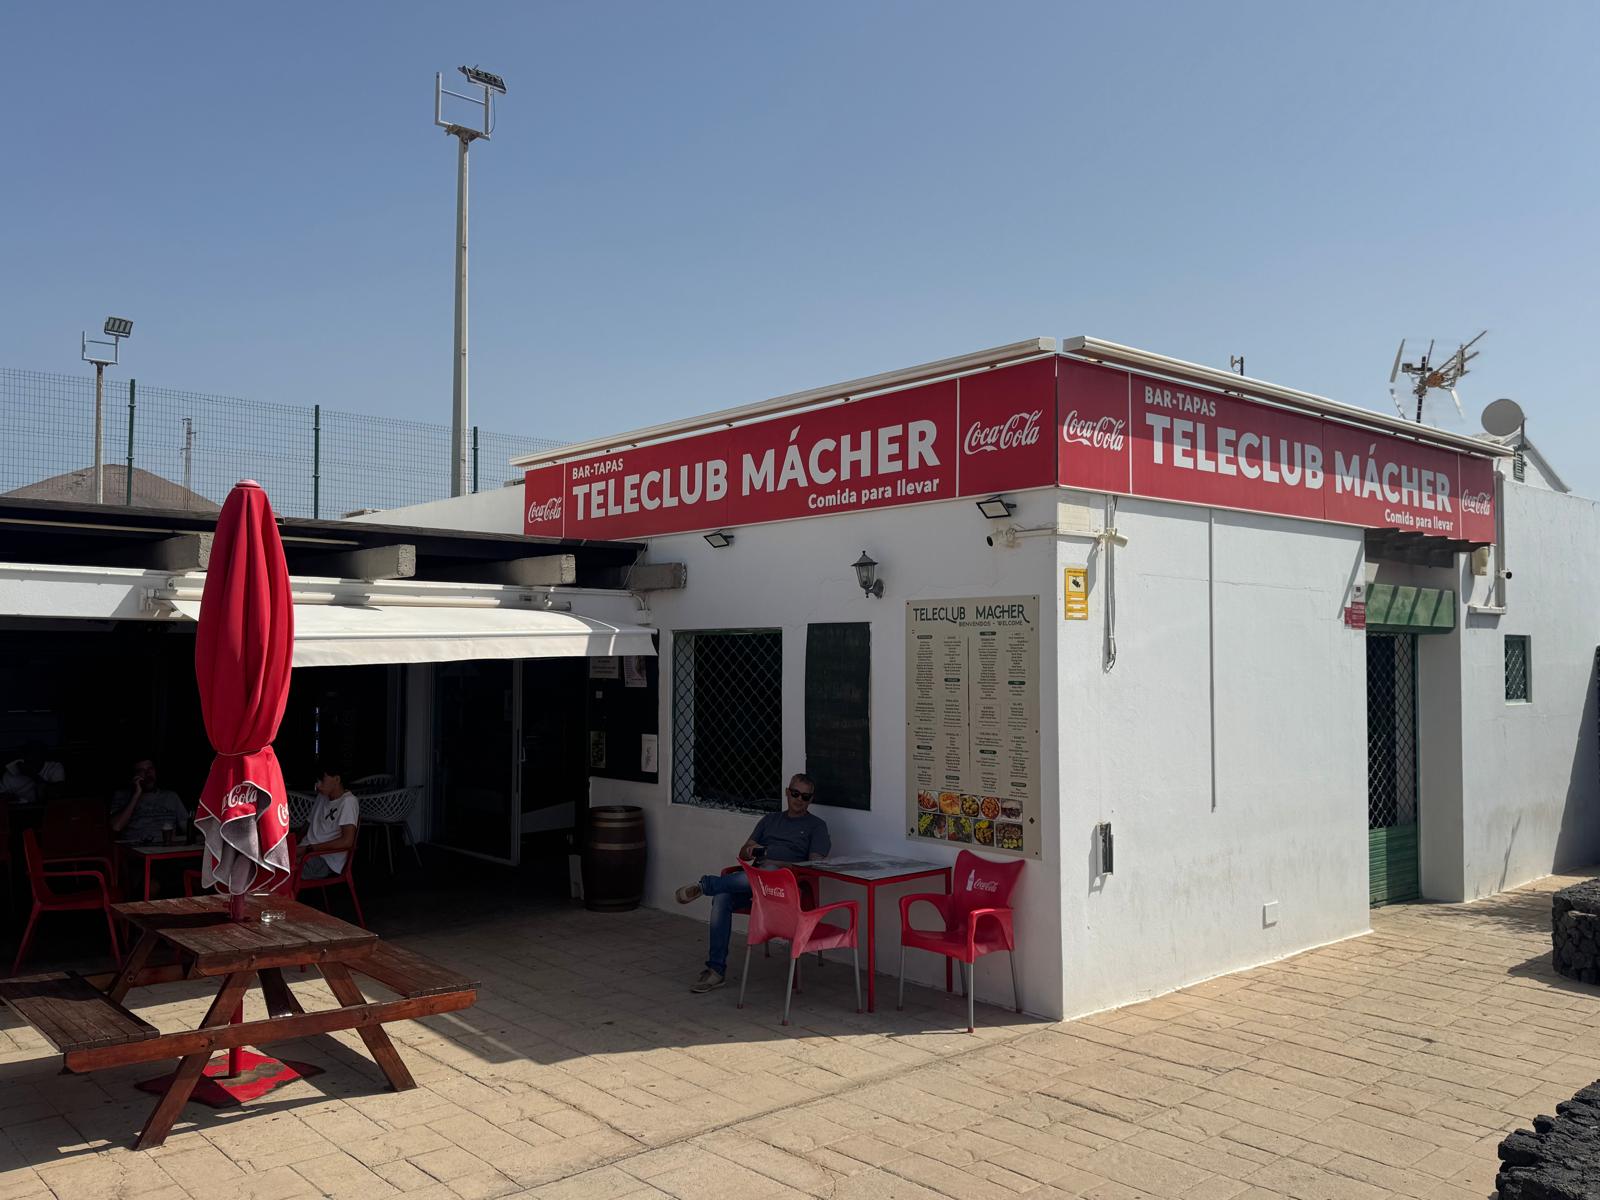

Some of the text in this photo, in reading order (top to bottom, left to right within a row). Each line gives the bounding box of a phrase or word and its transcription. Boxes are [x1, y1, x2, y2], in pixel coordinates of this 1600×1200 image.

[1145, 386, 1216, 417] BAR-TAPAS
[964, 409, 1043, 455] Coca-Cola
[1063, 410, 1125, 451] Coca-Cola
[572, 458, 624, 480] BAR-TAPAS
[573, 419, 940, 521] TELECLUB MÁCHER
[1146, 412, 1452, 513] TELECLUB MÁCHER
[808, 477, 940, 509] Comida para llevar
[1462, 489, 1491, 515] Coca-Cola
[528, 497, 562, 523] Coca-Cola
[1384, 508, 1453, 531] Comida para llevar
[913, 604, 1030, 623] TELECLUB MACHER
